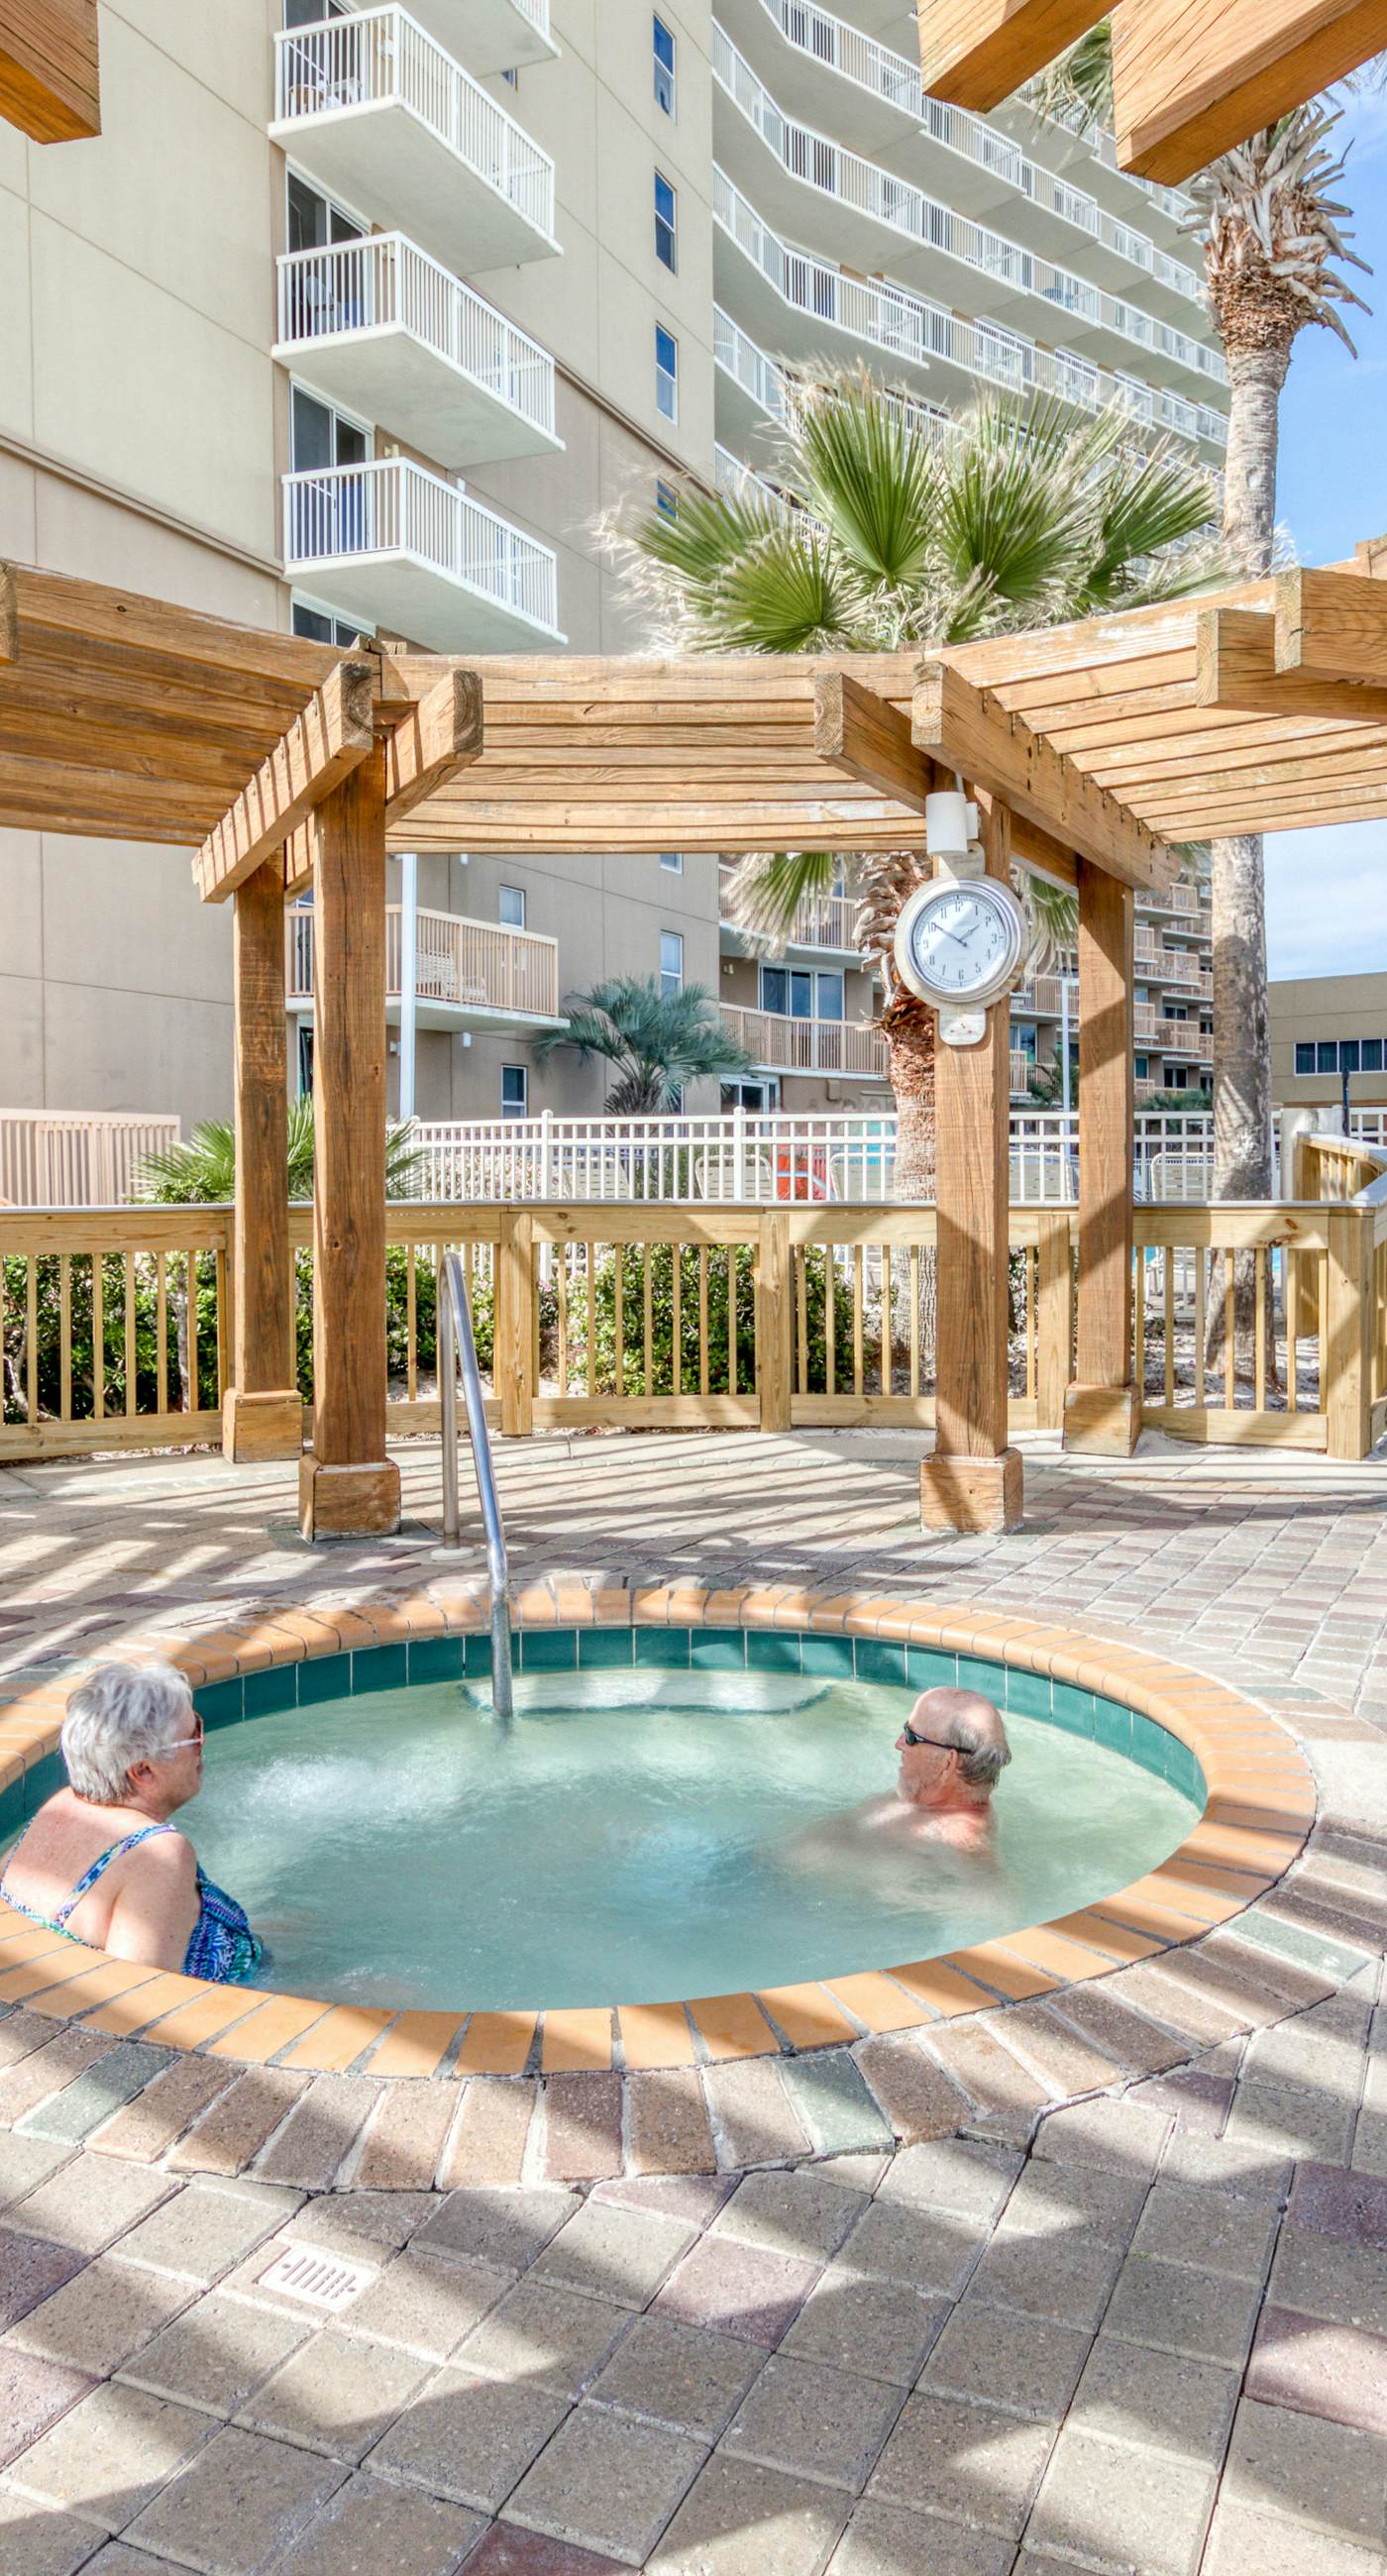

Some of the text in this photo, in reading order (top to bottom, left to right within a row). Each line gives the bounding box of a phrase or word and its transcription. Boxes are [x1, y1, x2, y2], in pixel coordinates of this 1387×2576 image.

[955, 900, 963, 912] 12
[975, 905, 979, 915] 1
[940, 907, 947, 919] 11
[927, 921, 936, 932] 10
[985, 915, 991, 927] 2
[991, 933, 998, 944] 3
[929, 955, 935, 965] 8
[975, 962, 981, 973] 5
[958, 969, 964, 980] 6
